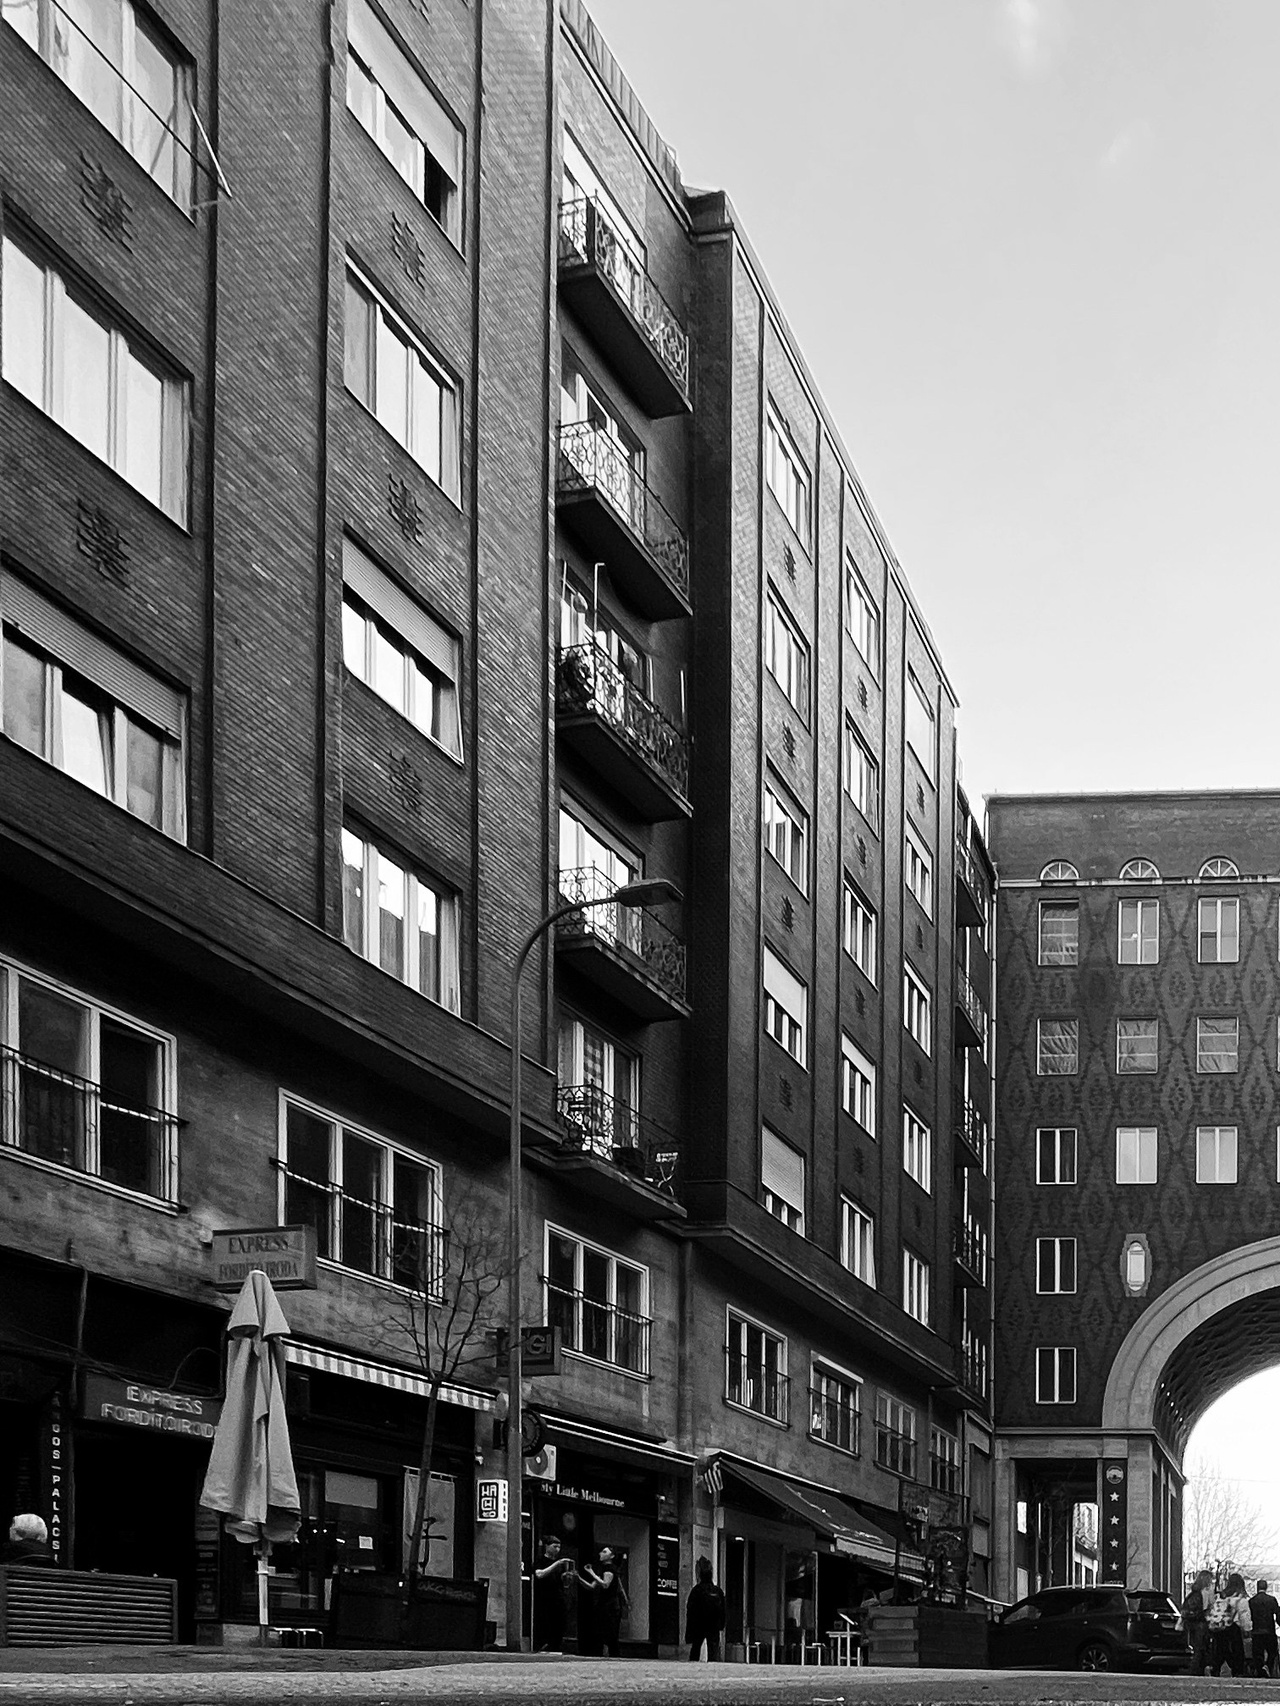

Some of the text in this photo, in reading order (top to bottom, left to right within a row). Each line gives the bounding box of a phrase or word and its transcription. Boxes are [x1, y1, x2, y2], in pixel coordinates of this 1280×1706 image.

[126, 1385, 203, 1415] EXPRESS
[101, 1402, 215, 1438] FORDÍTÓIROD
[540, 1482, 625, 1508] My Little Melbourne
